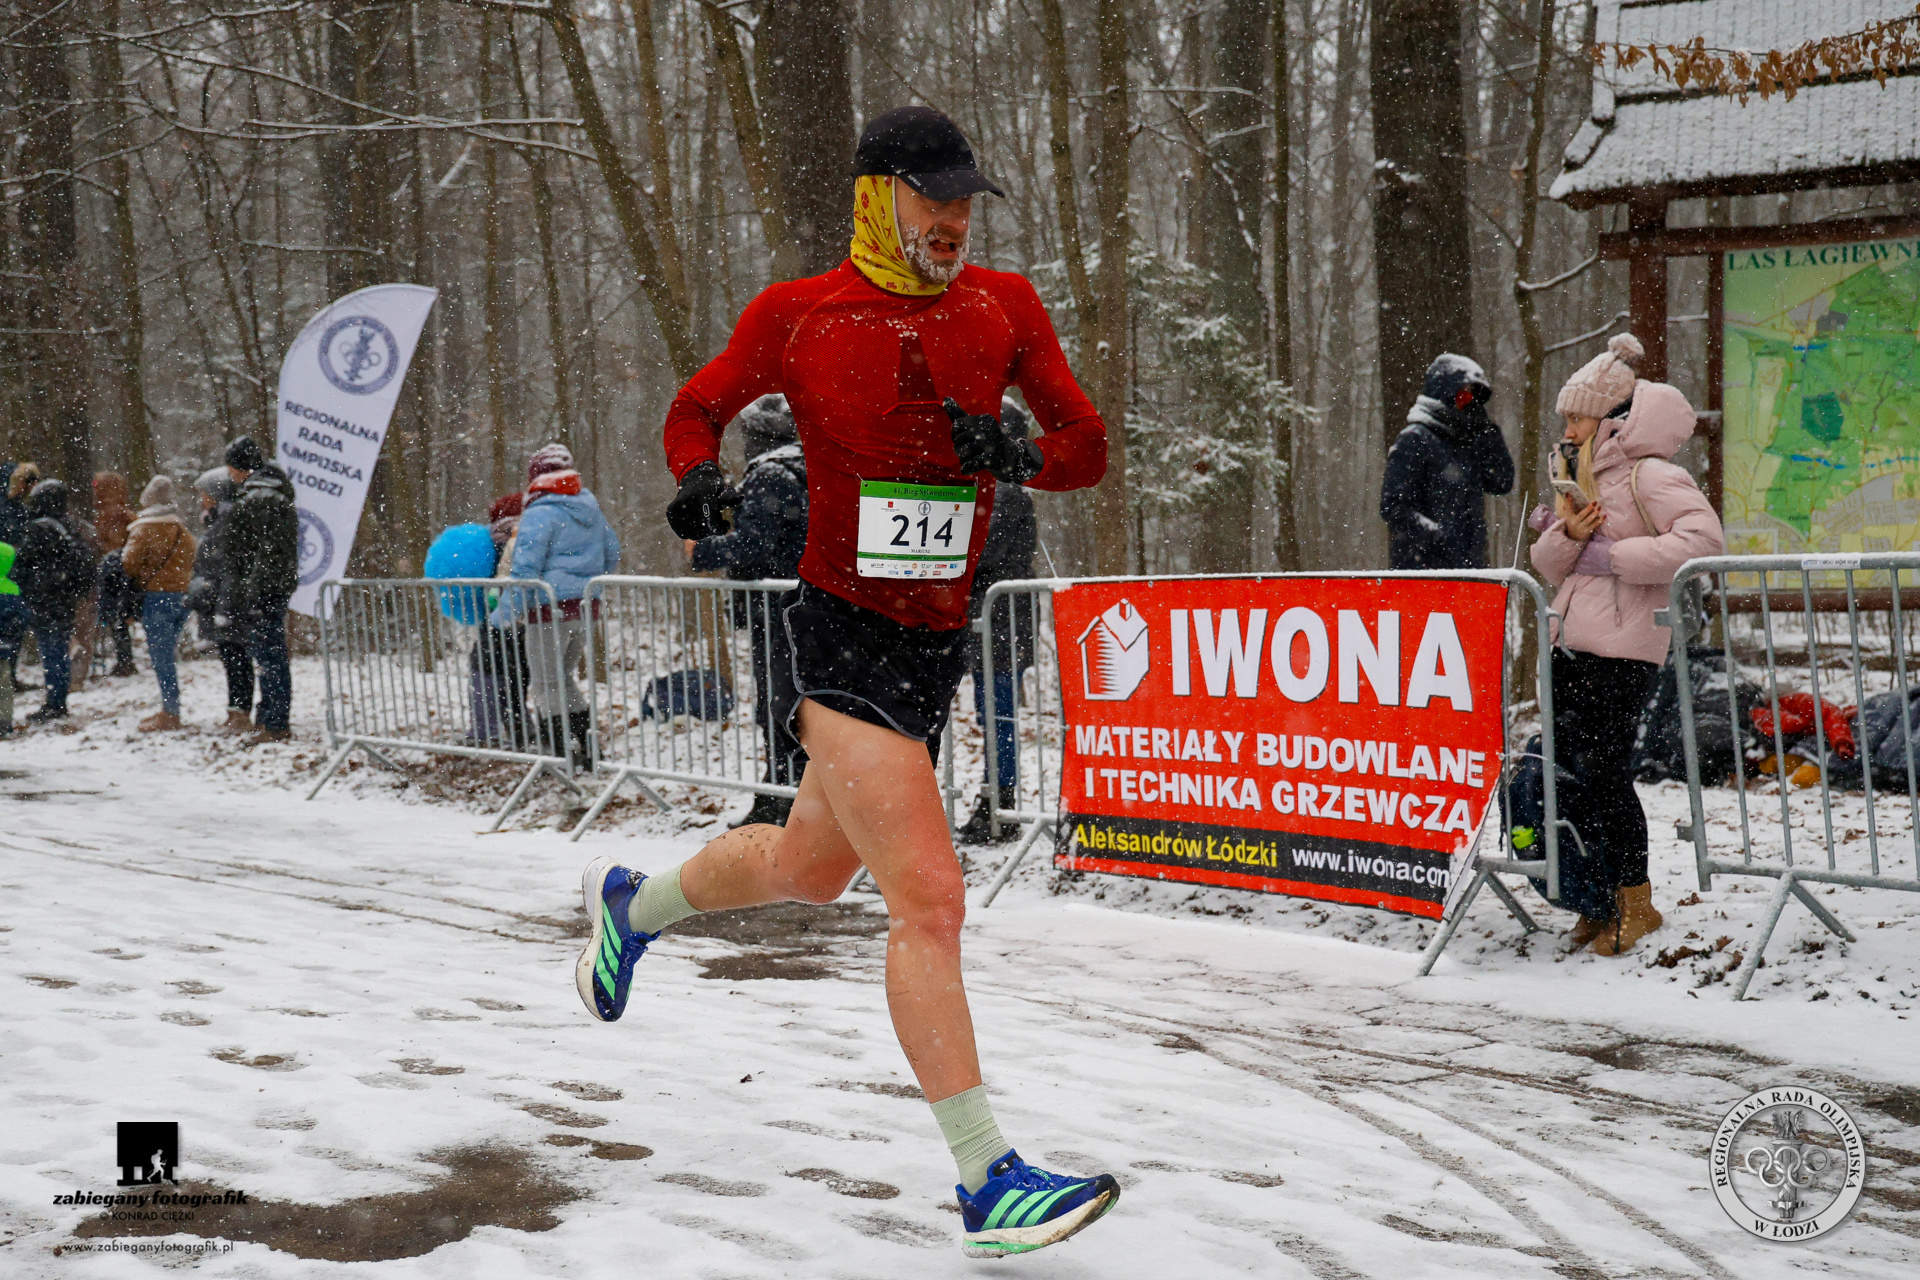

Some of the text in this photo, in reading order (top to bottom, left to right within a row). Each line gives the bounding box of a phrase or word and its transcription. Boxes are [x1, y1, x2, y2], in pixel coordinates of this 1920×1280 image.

[1727, 250, 1776, 271] LAS
[285, 400, 379, 442] REGIONALNA
[298, 426, 344, 452] RADA
[890, 514, 953, 547] 214
[1170, 607, 1473, 712] IWONA
[1075, 724, 1486, 788] MATERIAŁY BUDOWLANE
[1085, 767, 1473, 836] I TECHNIKA GRZEWCZA
[1075, 823, 1203, 859] Aleksandrów
[1205, 834, 1277, 868] Łódzki
